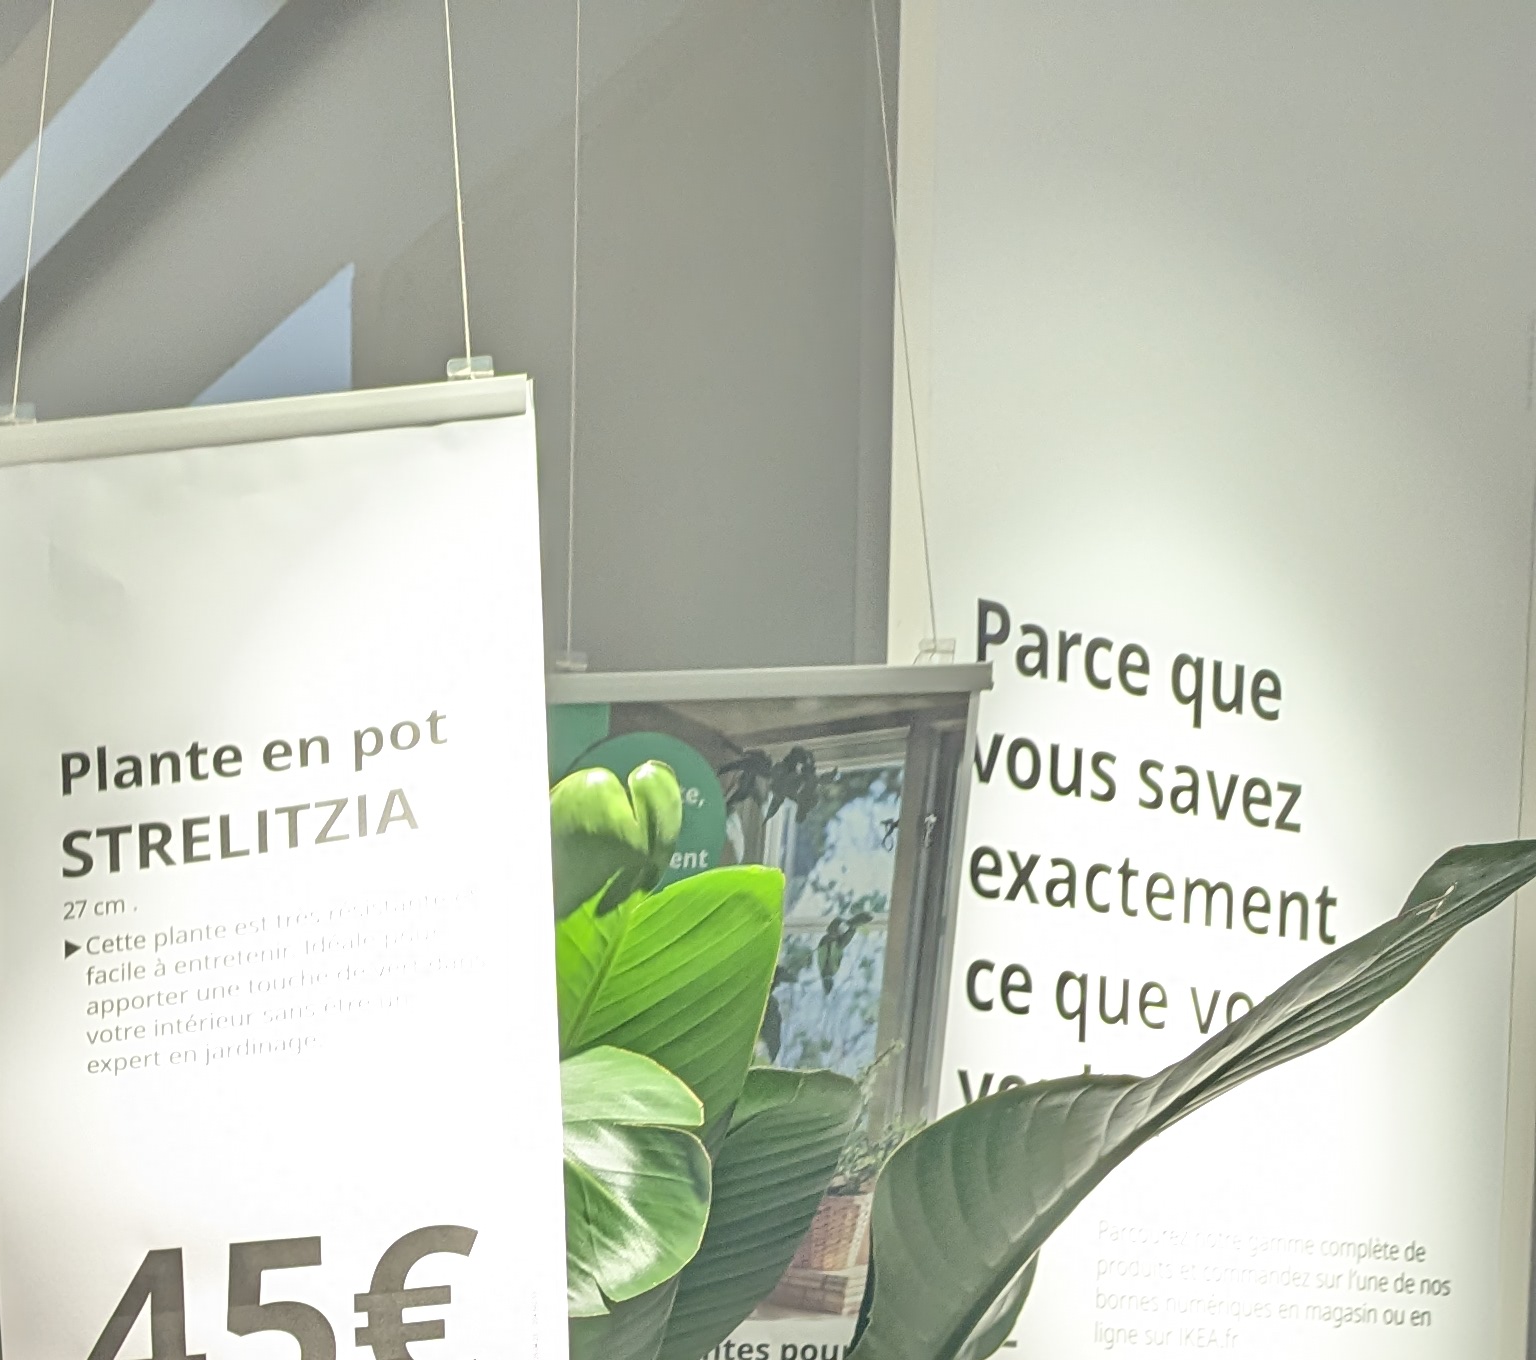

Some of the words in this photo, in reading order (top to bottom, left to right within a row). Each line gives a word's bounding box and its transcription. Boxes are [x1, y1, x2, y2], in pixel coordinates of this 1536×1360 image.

[976, 598, 1151, 697] Parce
[1171, 649, 1283, 729] que
[61, 740, 242, 796] Plante
[262, 733, 330, 772] en
[354, 710, 448, 771] pot
[974, 733, 1117, 803] vous
[1138, 757, 1304, 834] savez
[62, 788, 419, 878] STRELITZIA
[64, 899, 87, 921] 27
[94, 899, 125, 916] cm
[969, 844, 1338, 945] exactement
[86, 933, 146, 955] Cette
[154, 924, 226, 953] plante
[235, 916, 266, 936] est
[86, 962, 146, 986] facile
[154, 958, 166, 977] à
[174, 945, 295, 975] entretenir.
[86, 989, 188, 1019] apporter
[197, 983, 240, 1001] une
[965, 957, 1034, 1016] ce
[1055, 974, 1168, 1043] que
[86, 1024, 146, 1045] votre
[154, 1012, 253, 1037] intérieur
[87, 1051, 161, 1076] expert
[169, 1049, 197, 1065] en
[1320, 1237, 1400, 1264] complète
[1404, 1240, 1426, 1263] de
[1316, 1272, 1343, 1289] sur
[1393, 1272, 1415, 1294] de
[1420, 1278, 1452, 1297] nos
[1095, 1286, 1159, 1312] bornes
[1278, 1303, 1299, 1319] en
[1305, 1303, 1378, 1329] magasin
[1383, 1308, 1405, 1326] ou
[1410, 1309, 1432, 1327] en
[1094, 1321, 1138, 1350] ligne
[1145, 1328, 1173, 1346] sur
